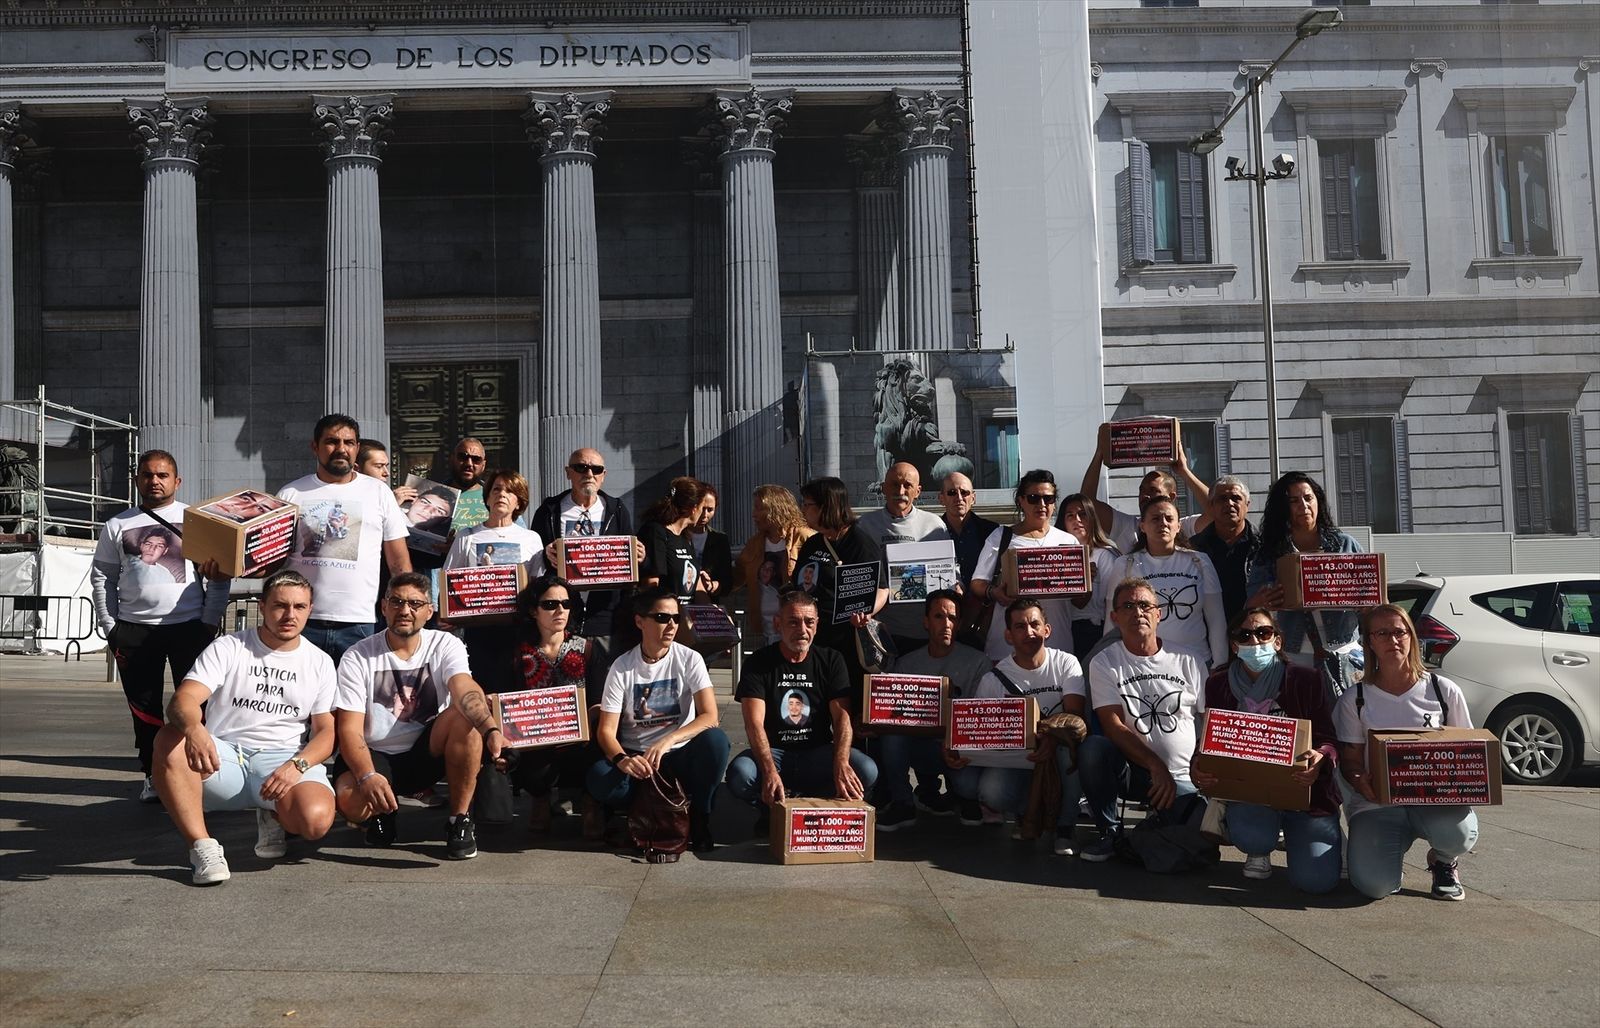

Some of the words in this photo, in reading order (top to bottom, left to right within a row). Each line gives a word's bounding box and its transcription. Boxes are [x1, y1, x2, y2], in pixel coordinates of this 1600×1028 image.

[204, 49, 371, 73] CONGRESO
[395, 47, 433, 70] DE
[458, 47, 513, 69] LOS
[539, 44, 712, 68] DIPUTADOS
[842, 567, 873, 576] ALCOHOL
[1320, 563, 1354, 571] 143.000
[464, 574, 496, 582] 106.000
[248, 666, 297, 683] JUSTICIA
[256, 683, 284, 698] PARA
[892, 684, 919, 692] 98.000
[520, 697, 554, 707] 106.000
[232, 697, 300, 718] MARQUITOS
[1229, 719, 1268, 730] 143.000
[1212, 731, 1237, 739] MURIÓ
[1238, 735, 1291, 747] ATROPELLADA
[1222, 726, 1239, 734] HIJA
[1242, 729, 1263, 737] TENÍA
[1270, 734, 1292, 742] AÑOS
[1219, 738, 1248, 746] conductor
[1424, 752, 1454, 760] 7.000
[820, 818, 843, 826] 1.000
